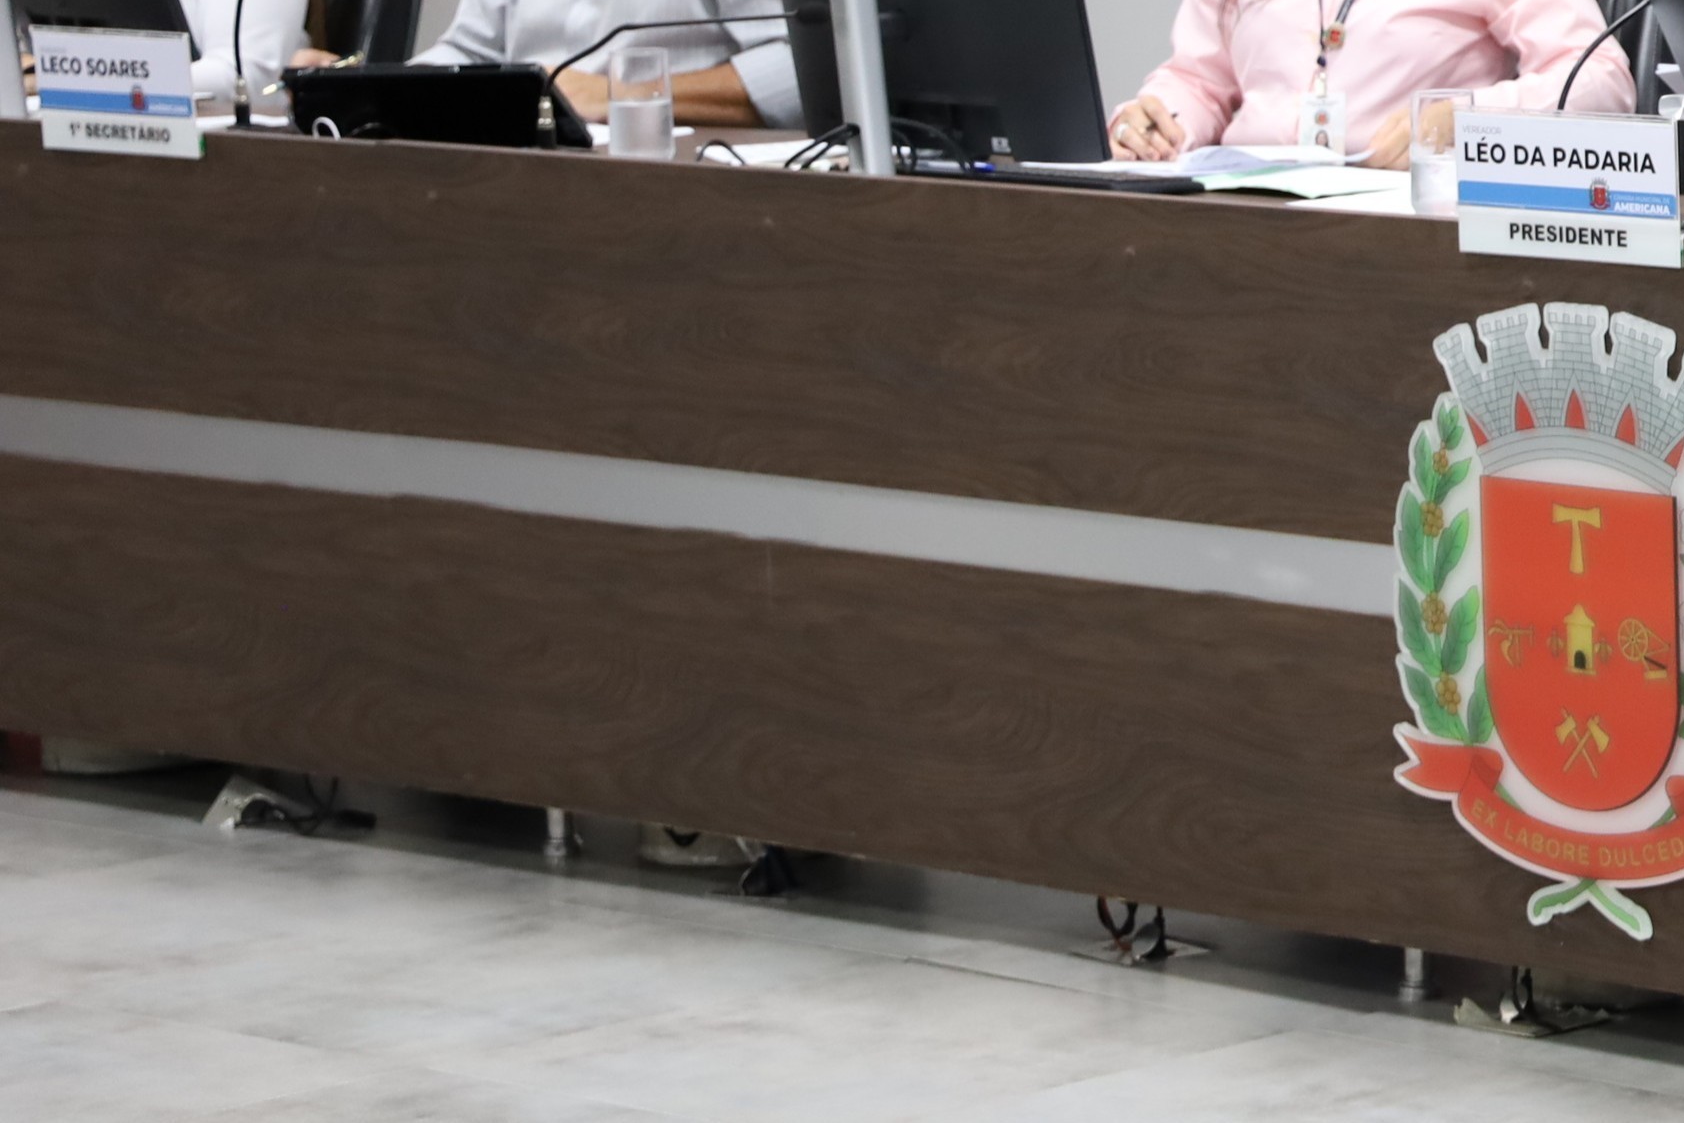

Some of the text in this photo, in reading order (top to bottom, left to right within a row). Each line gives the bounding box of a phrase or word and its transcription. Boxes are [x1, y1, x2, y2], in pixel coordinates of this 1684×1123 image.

[40, 55, 150, 78] LECO SOARES
[1464, 136, 1656, 174] LÉO DA PADARIA
[1614, 201, 1670, 215] AMERICANA
[1509, 222, 1628, 248] PRESIDENTE
[1470, 798, 1499, 828] EX
[1503, 821, 1591, 866] LABORE
